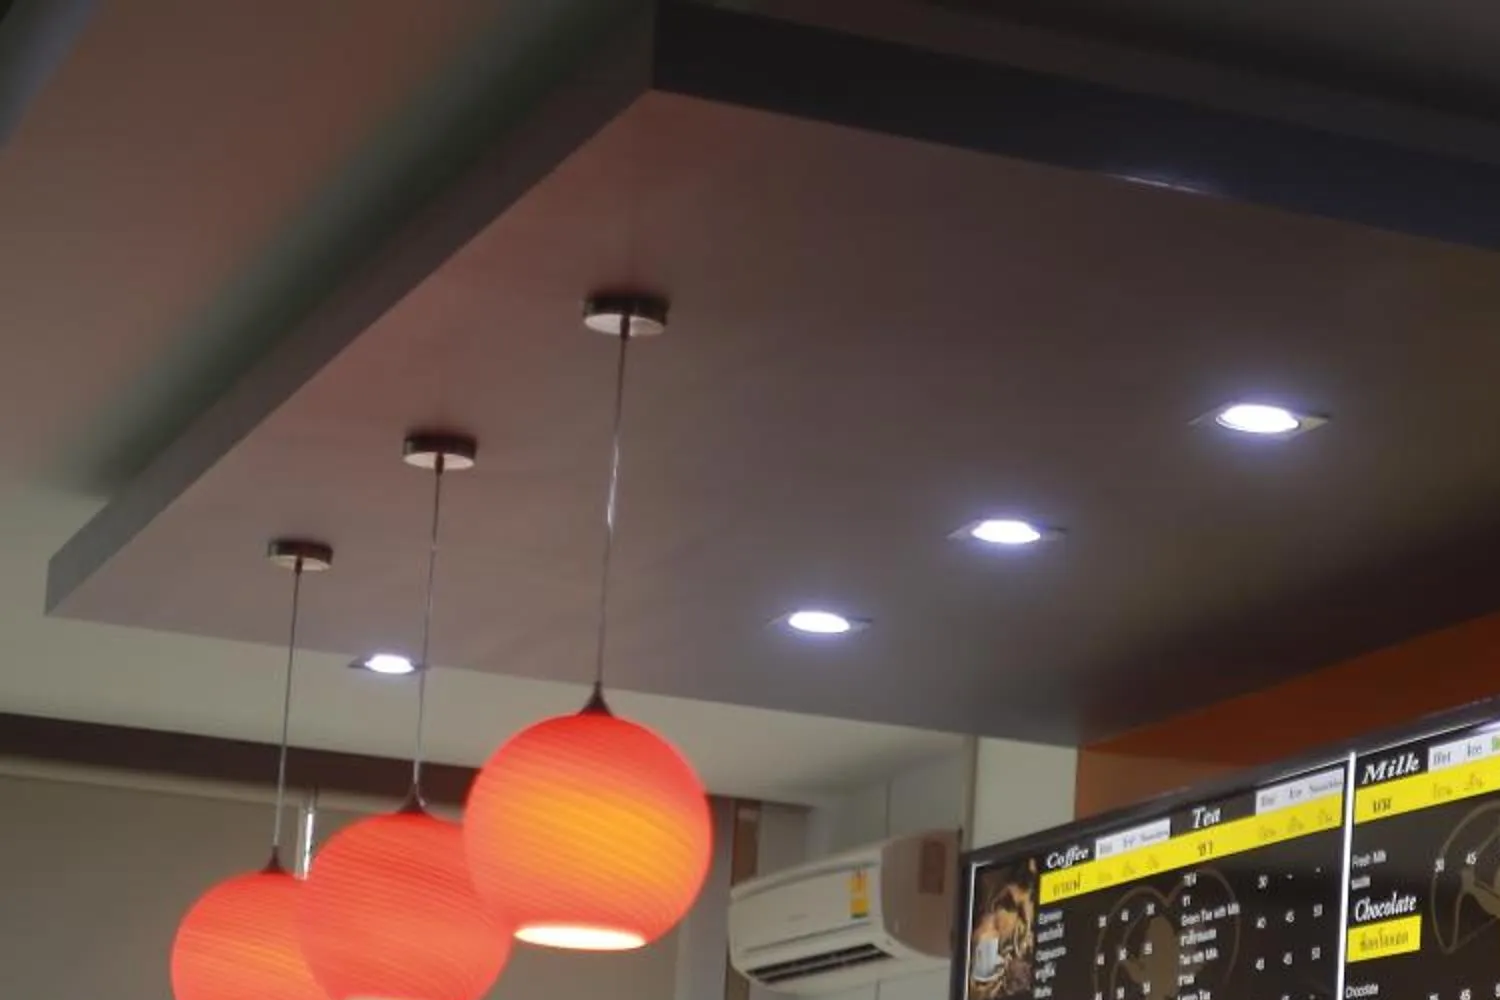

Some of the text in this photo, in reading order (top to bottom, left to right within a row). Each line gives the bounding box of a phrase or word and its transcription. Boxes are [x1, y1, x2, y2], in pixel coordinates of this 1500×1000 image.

[1361, 753, 1421, 785] Milk
[1191, 806, 1222, 829] Tea
[1046, 844, 1090, 869] Coffee
[1354, 889, 1417, 923] Chocolate
